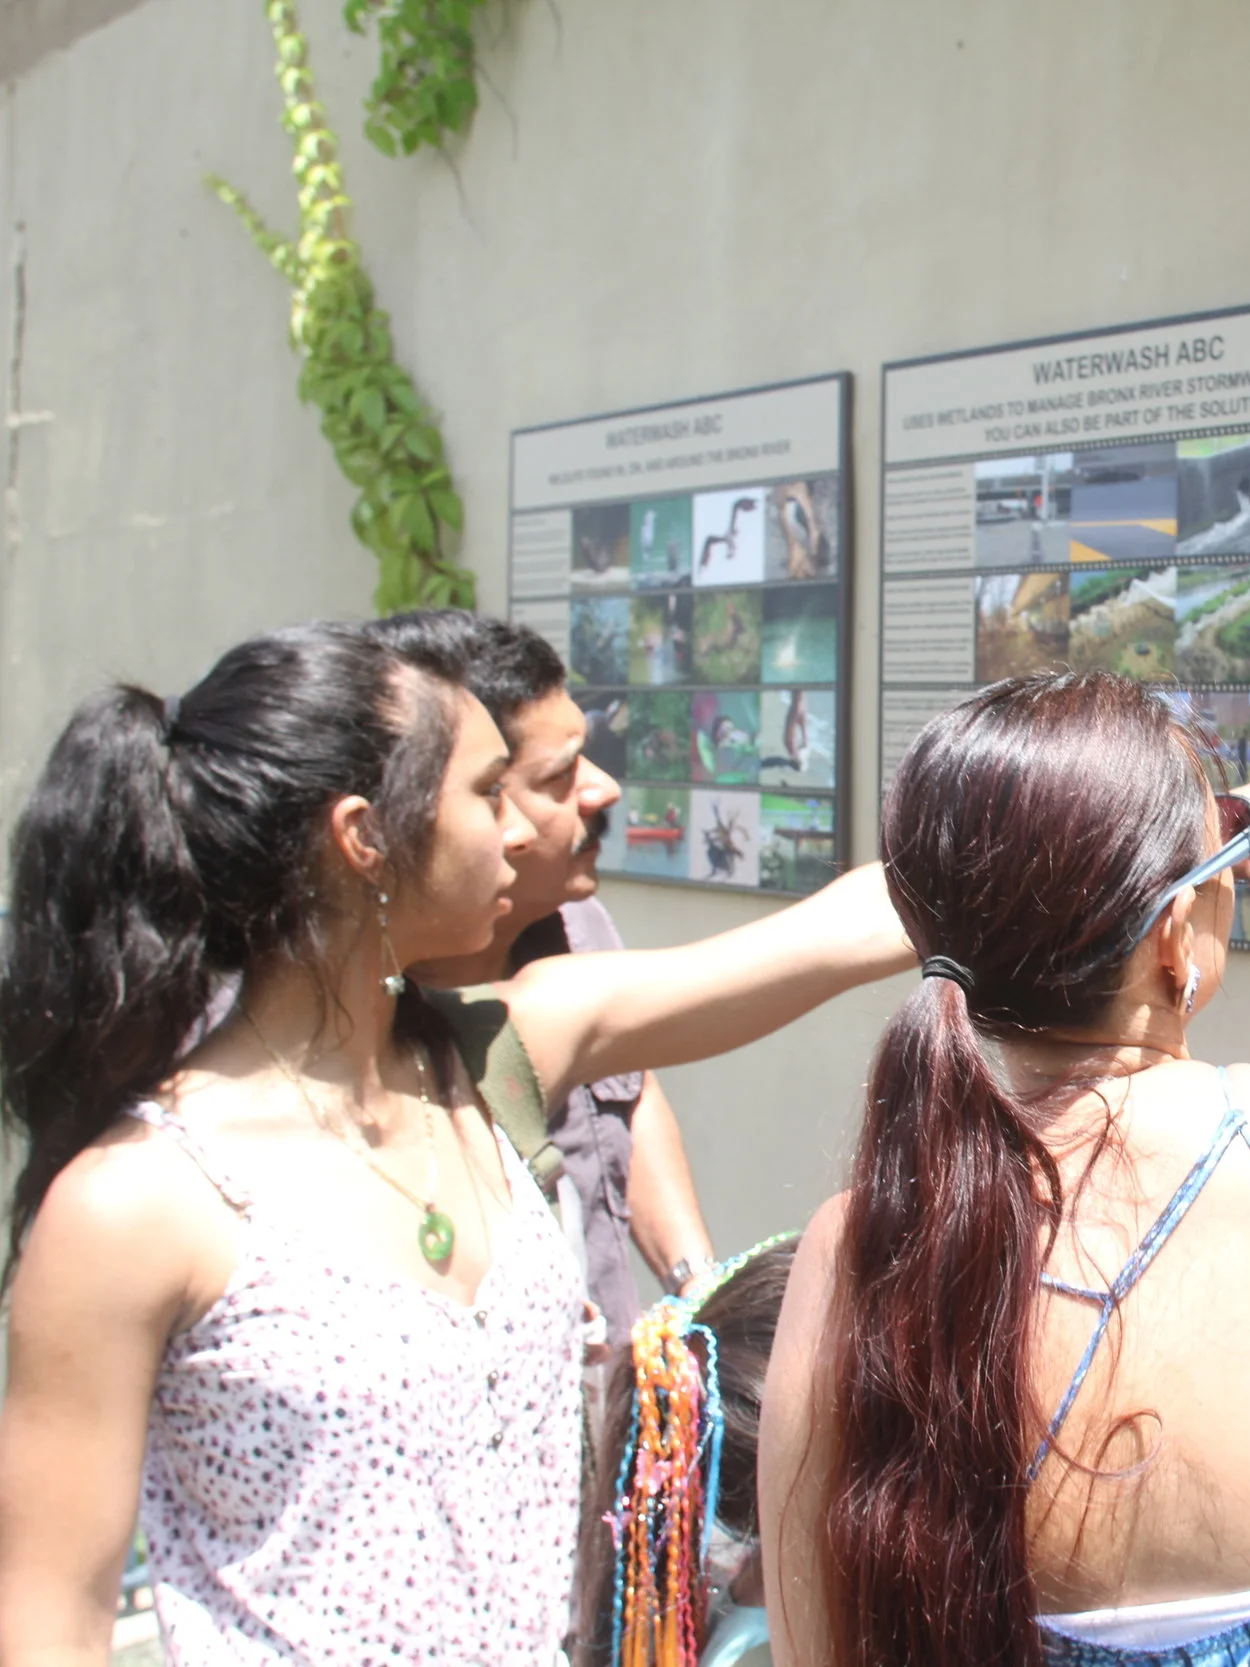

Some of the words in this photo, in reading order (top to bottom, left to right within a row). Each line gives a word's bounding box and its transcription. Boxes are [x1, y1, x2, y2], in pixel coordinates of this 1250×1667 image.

[1033, 344, 1169, 385] WATERWASH
[1175, 335, 1225, 366] ABC
[902, 413, 934, 432] USES
[937, 402, 1004, 426] WETLANDS
[1006, 400, 1025, 417] TO
[1027, 391, 1083, 414] MANAGE
[1087, 385, 1136, 407] BRONX
[1139, 378, 1183, 401] RIVER
[984, 425, 1011, 442] YOU
[1014, 422, 1042, 440] CAN
[1045, 416, 1079, 436] ALSO
[1083, 414, 1101, 431] BE
[1104, 407, 1138, 428] PART
[1143, 407, 1163, 425] OF
[1168, 401, 1196, 421] THE
[606, 418, 689, 449] WATERWASH
[693, 412, 723, 436] ABC
